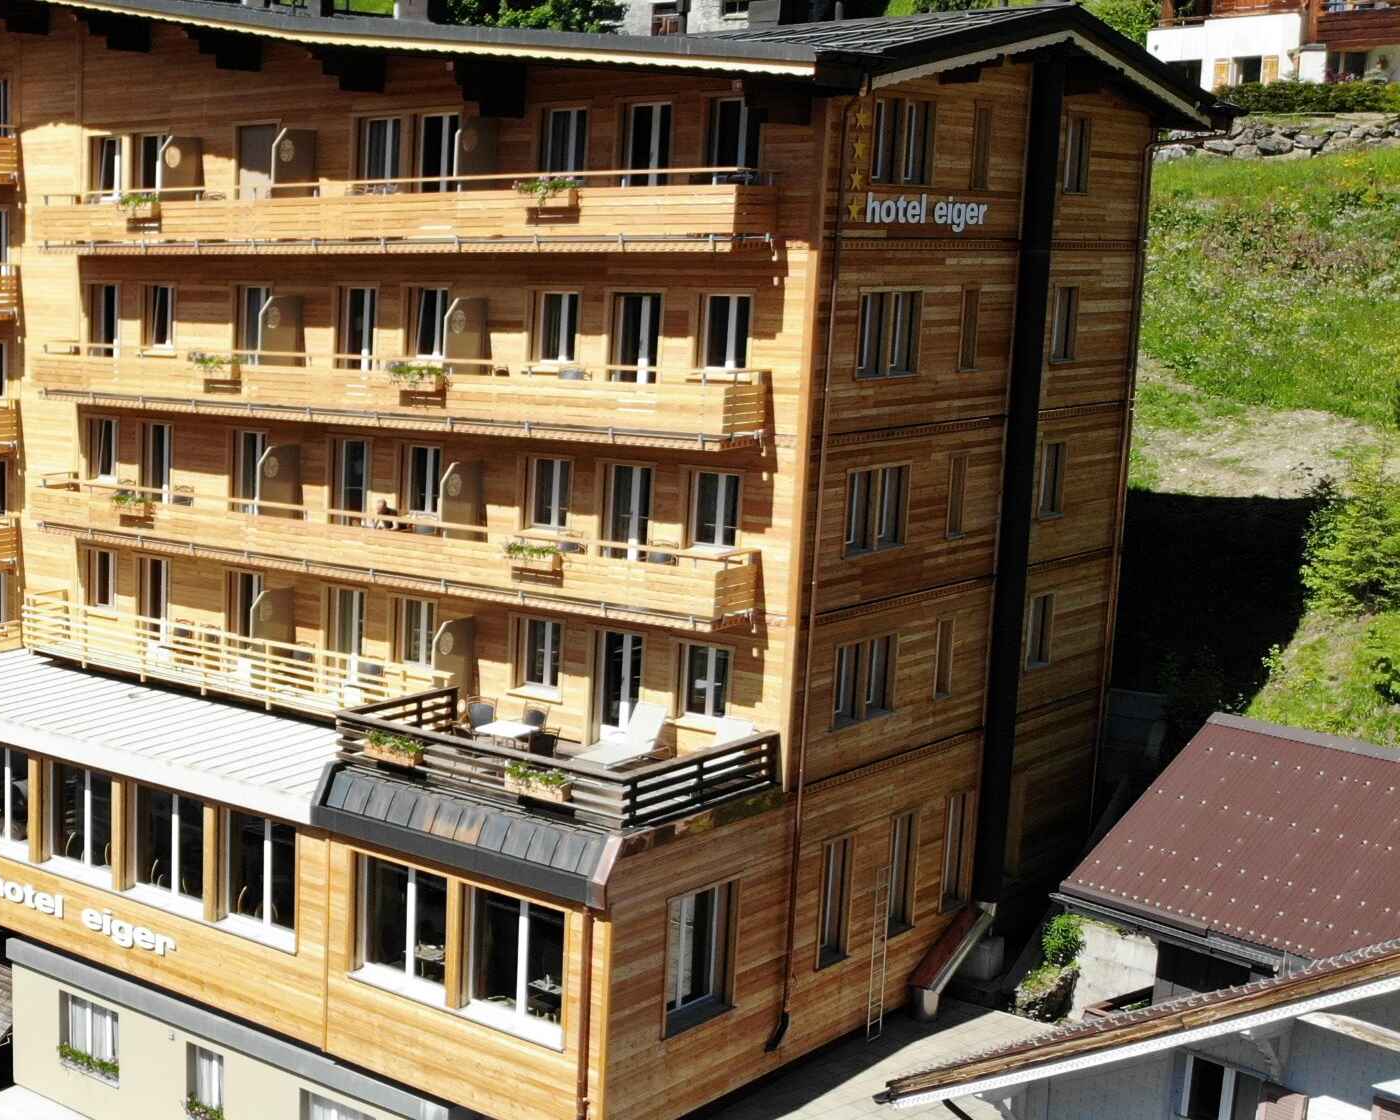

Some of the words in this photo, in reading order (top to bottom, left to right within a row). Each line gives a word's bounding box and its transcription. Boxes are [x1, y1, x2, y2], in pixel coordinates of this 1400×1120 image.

[867, 192, 927, 224] hotel
[934, 197, 988, 232] eiger
[80, 907, 176, 957] eiger
